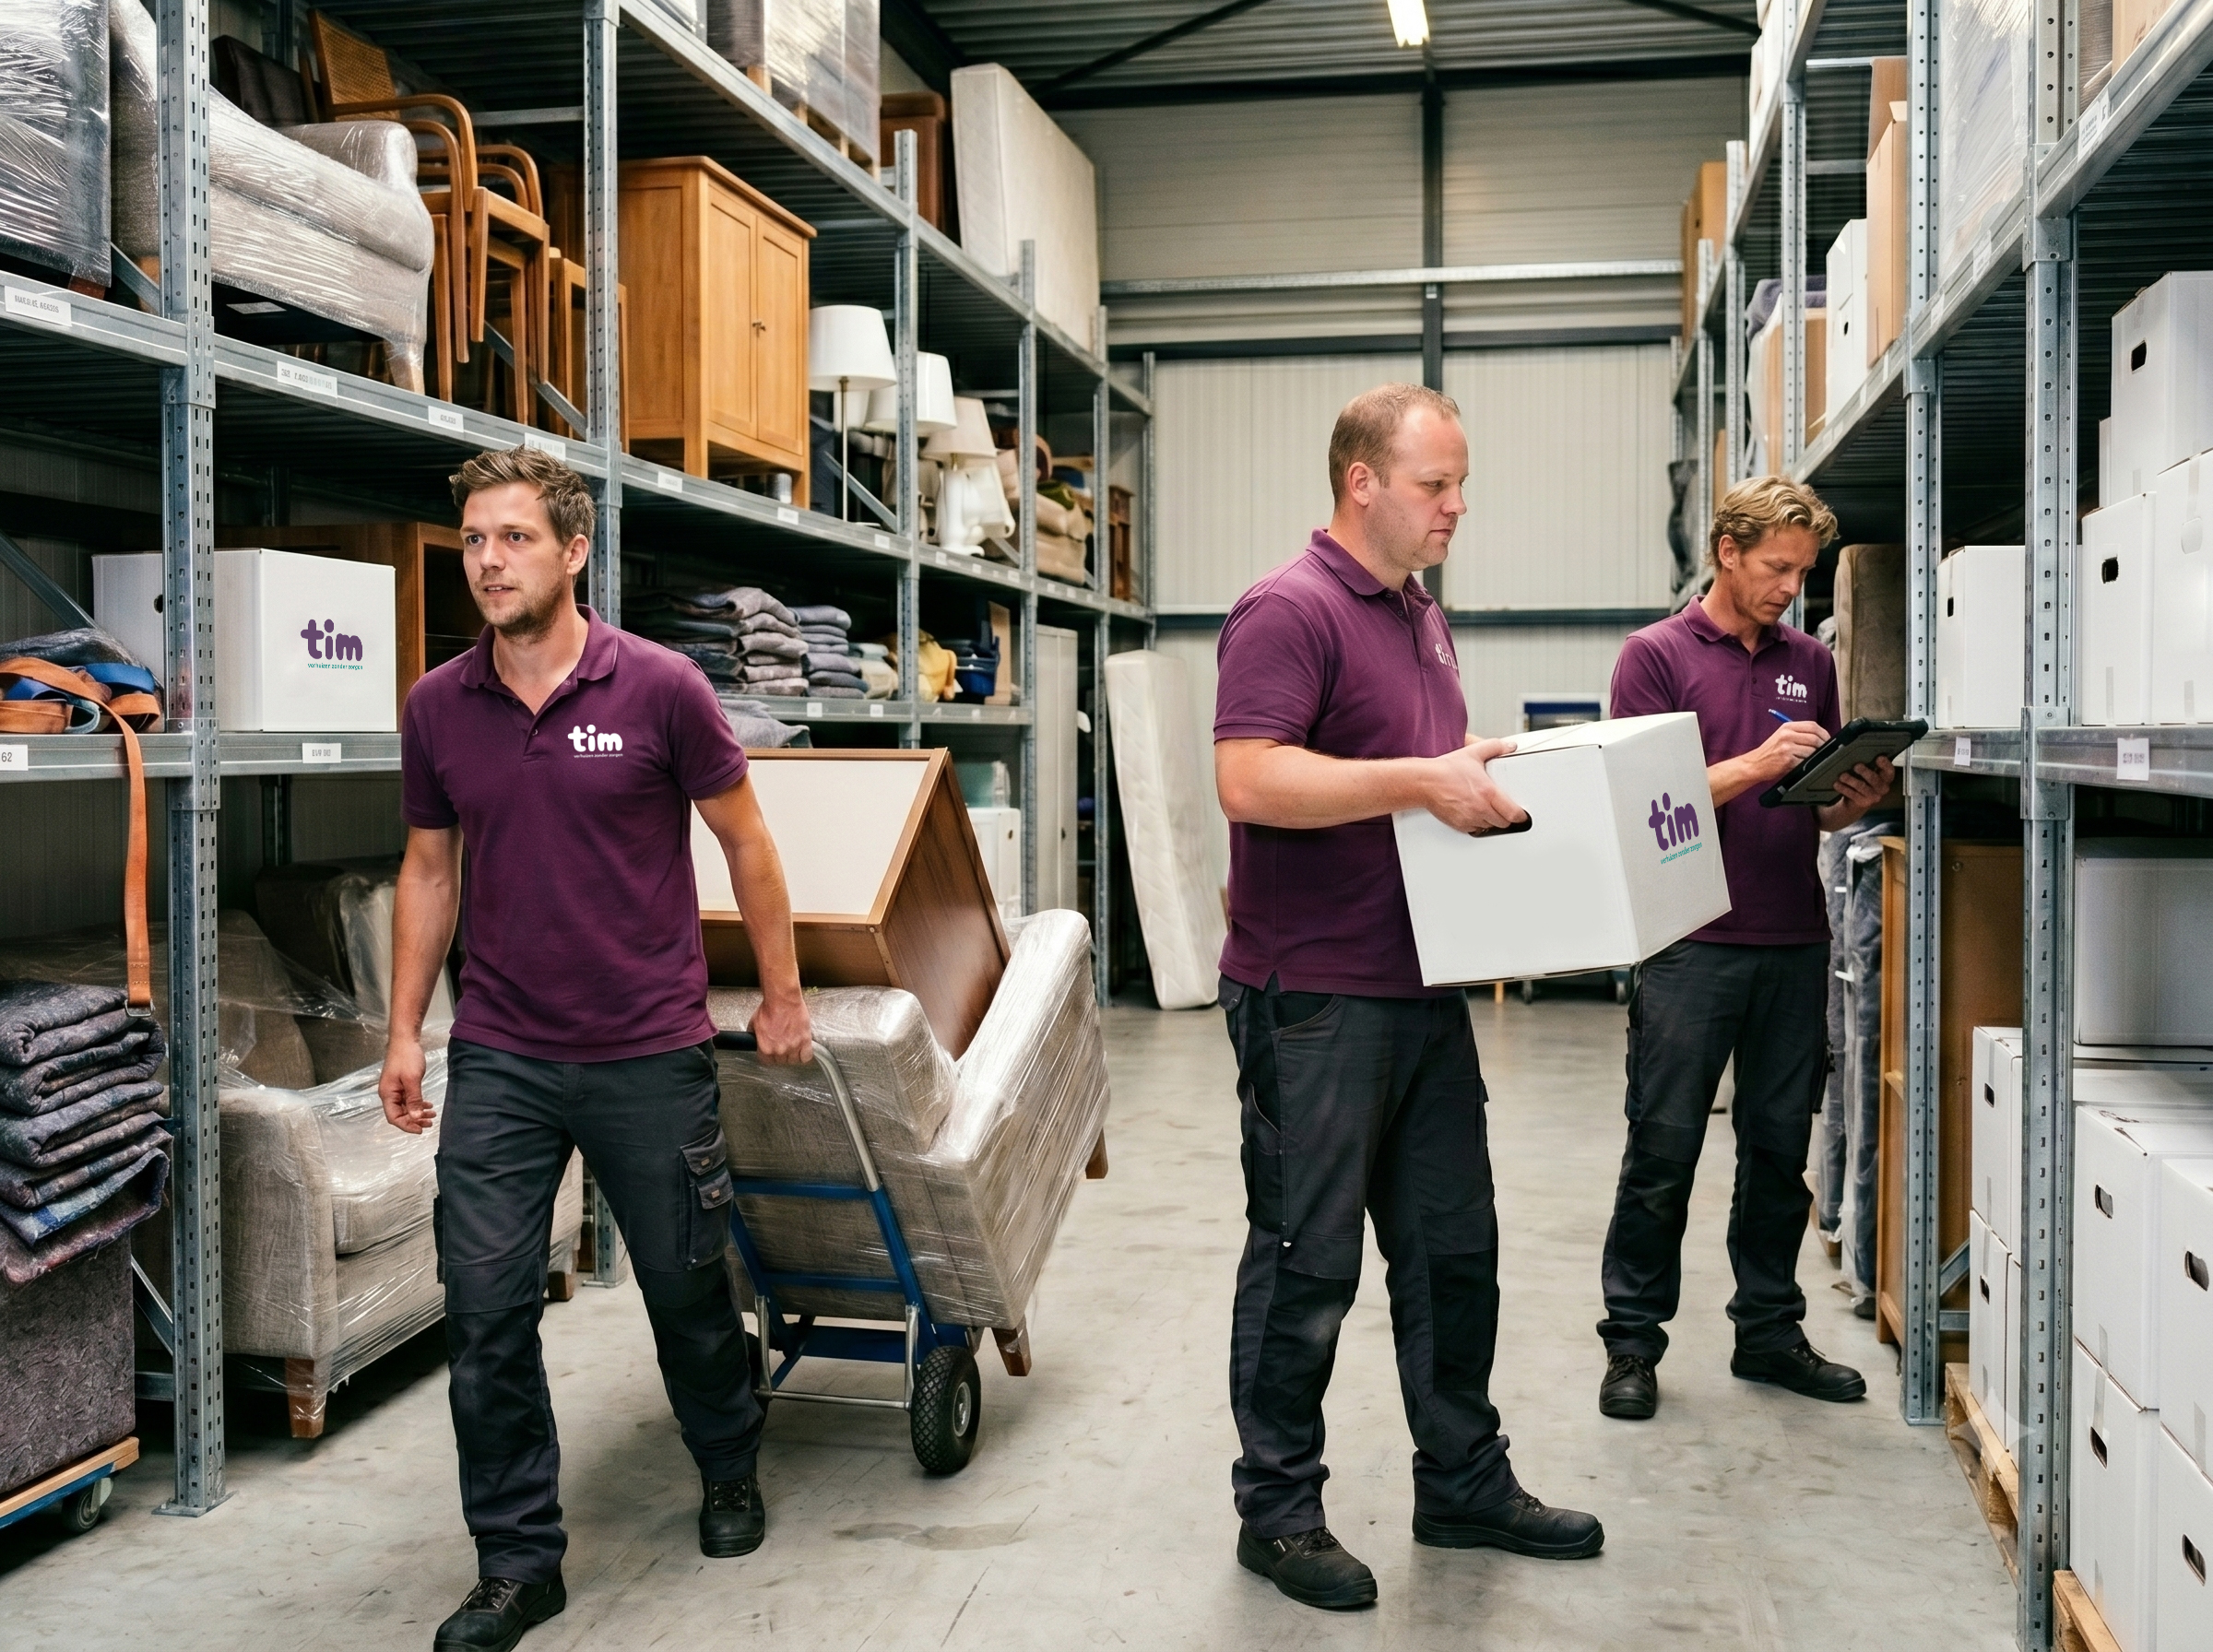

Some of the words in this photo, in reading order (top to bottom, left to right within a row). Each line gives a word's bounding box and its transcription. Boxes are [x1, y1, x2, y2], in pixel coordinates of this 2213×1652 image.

[301, 619, 363, 661] tim
[1775, 674, 1807, 698] tim
[567, 724, 623, 752] tim
[1, 751, 13, 762] 62
[1649, 792, 1699, 851] tim
